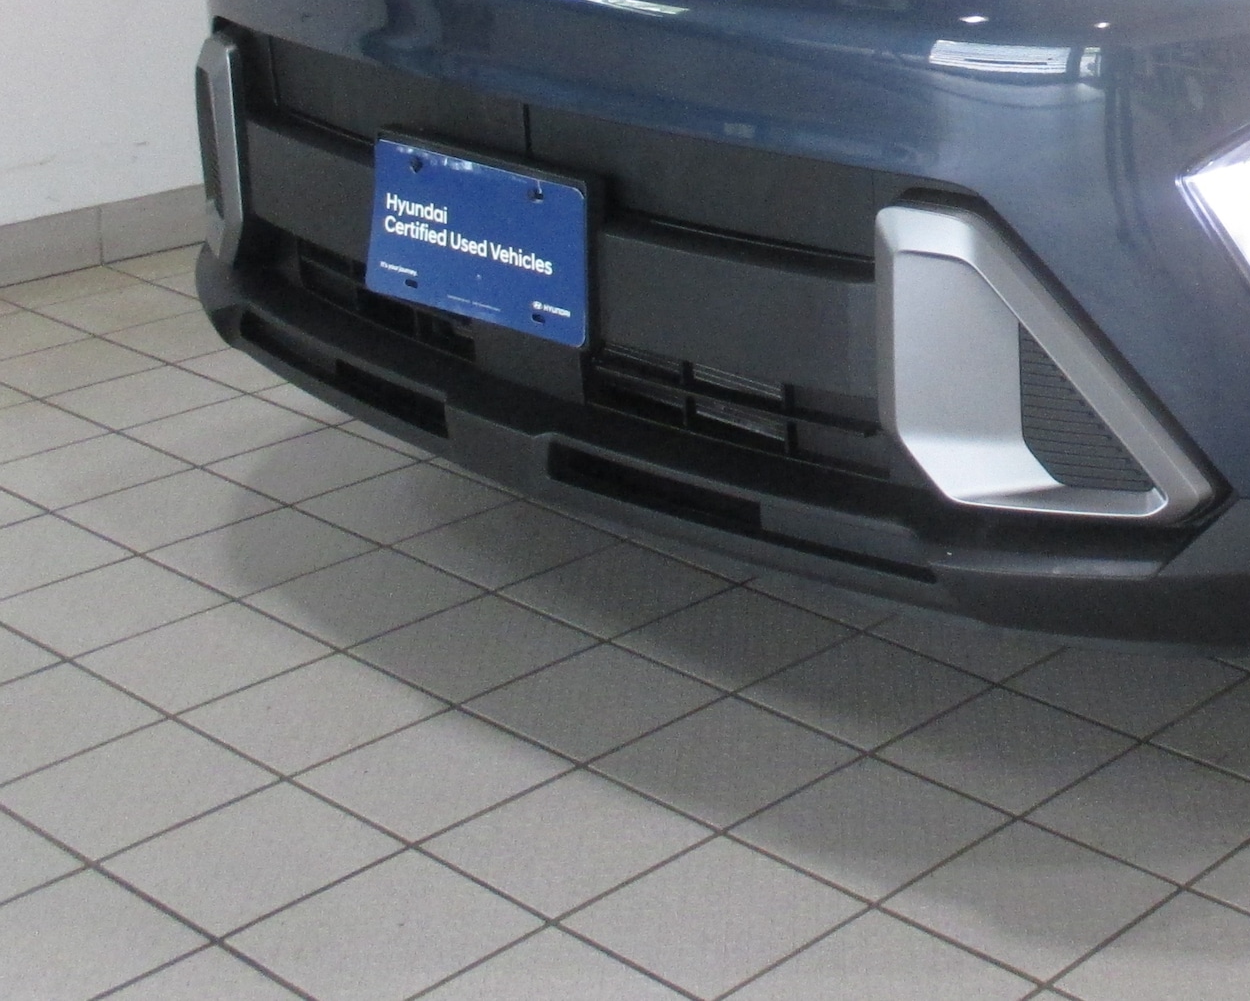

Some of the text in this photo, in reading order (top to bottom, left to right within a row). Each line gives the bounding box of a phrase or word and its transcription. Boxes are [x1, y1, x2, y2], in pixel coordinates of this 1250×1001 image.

[386, 192, 449, 224] Hyundai
[384, 216, 554, 276] Certified Used Vehicles
